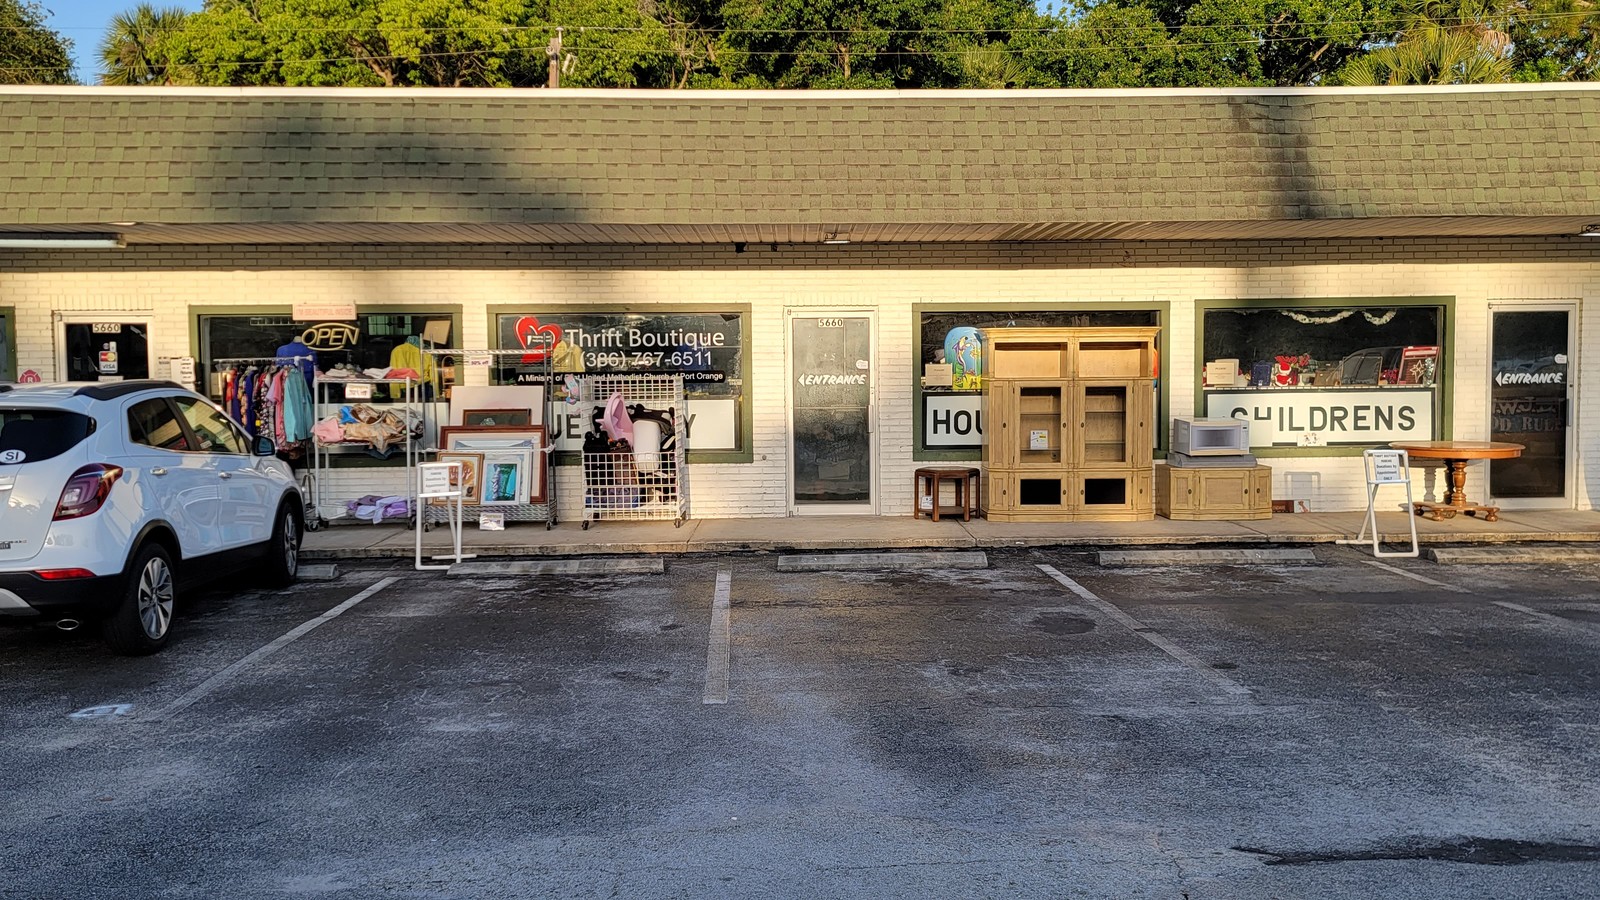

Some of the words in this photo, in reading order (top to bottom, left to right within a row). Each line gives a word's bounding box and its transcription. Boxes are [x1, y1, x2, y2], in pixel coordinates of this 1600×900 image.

[94, 324, 120, 332] 5660
[819, 319, 843, 327] 5660
[302, 328, 360, 346] OPEN
[564, 328, 622, 348] Thrift
[629, 328, 725, 352] Boutique
[580, 351, 626, 367] (386)
[632, 350, 712, 366] 767-6511
[696, 372, 724, 381] Orange
[805, 374, 867, 385] ENTRANCE
[1502, 372, 1564, 384] ENTRANCE
[5, 451, 19, 460] SI
